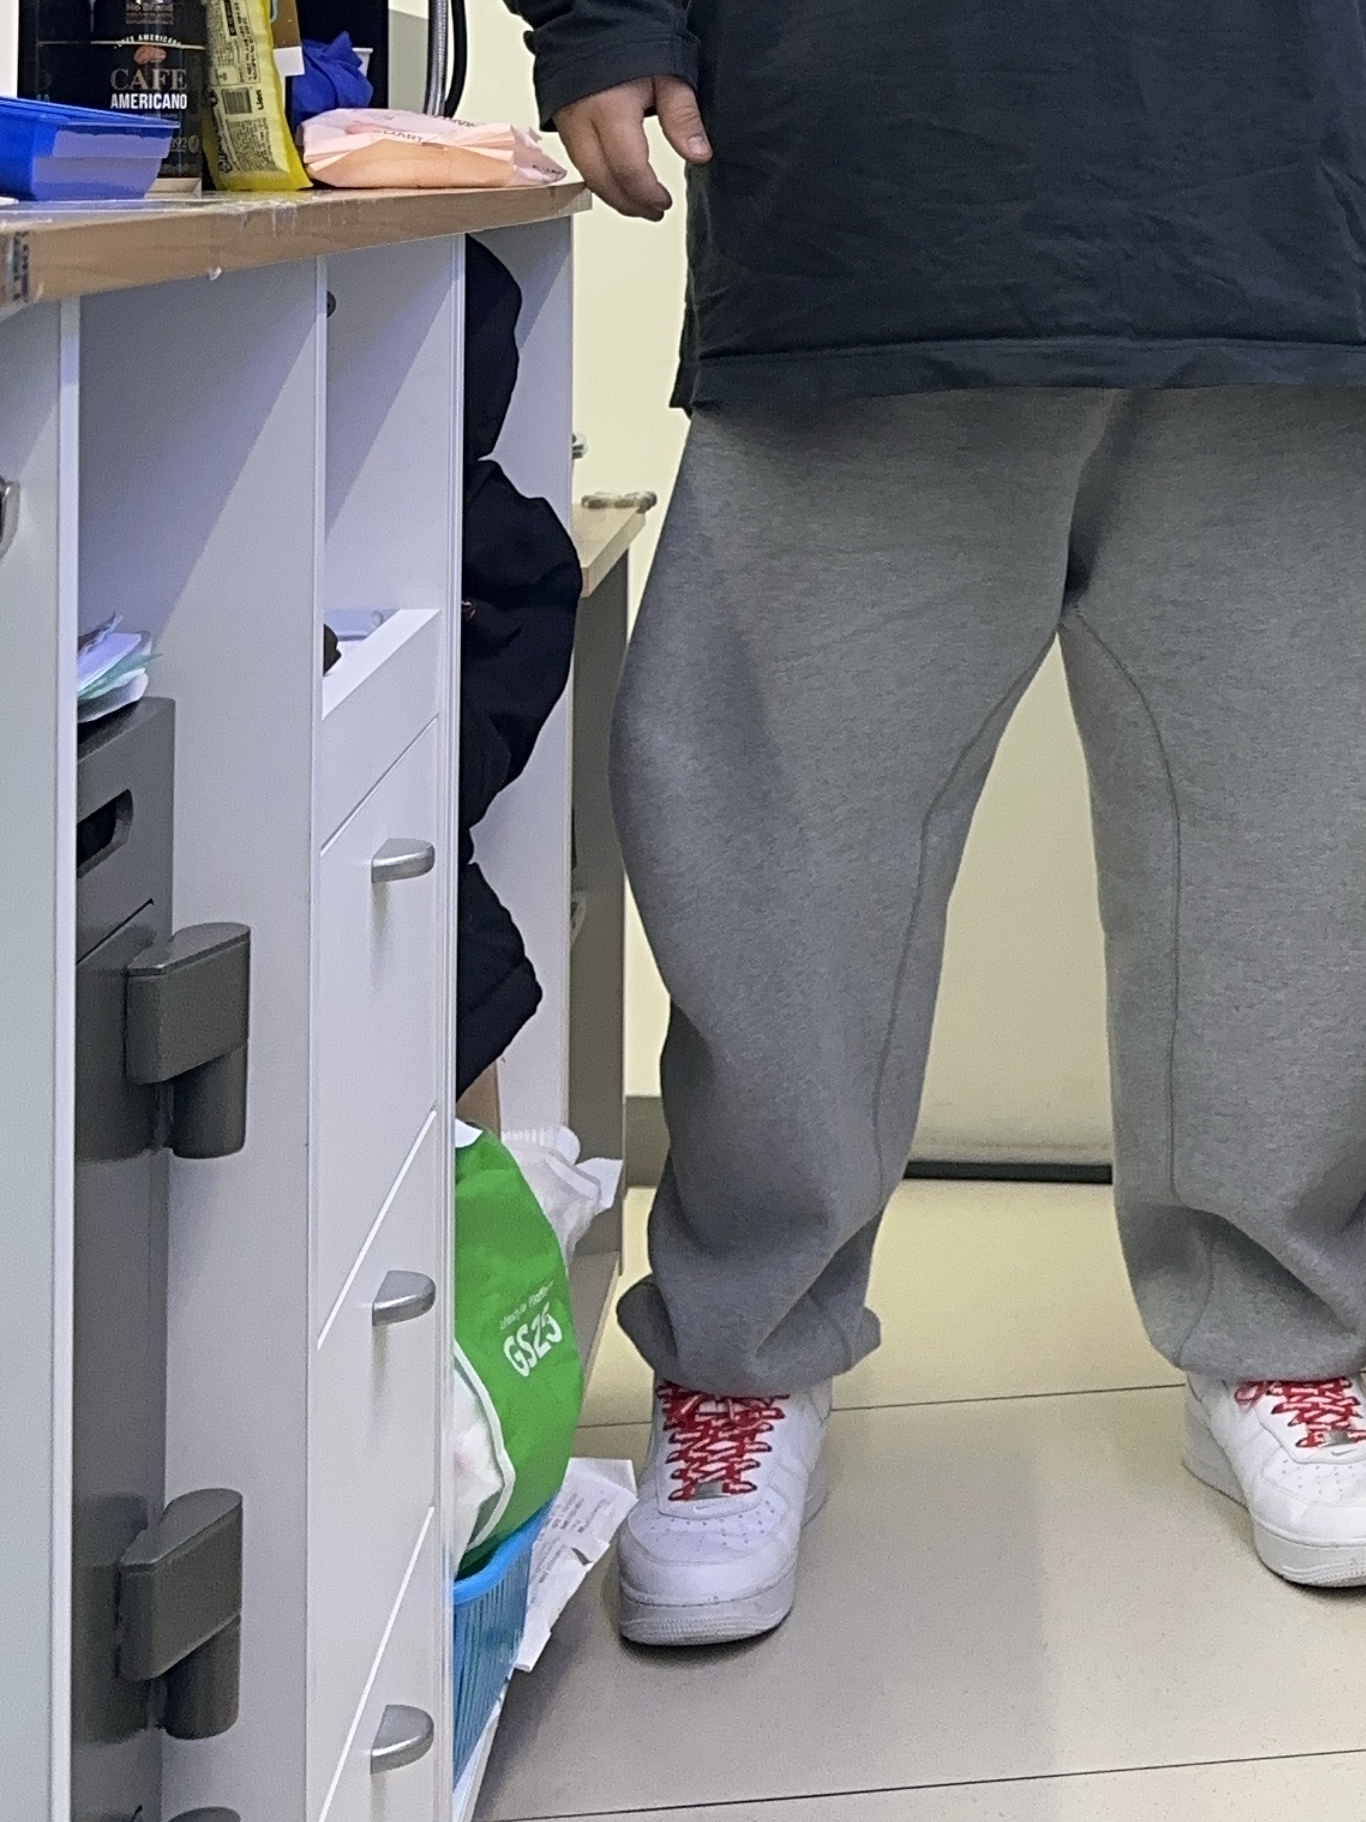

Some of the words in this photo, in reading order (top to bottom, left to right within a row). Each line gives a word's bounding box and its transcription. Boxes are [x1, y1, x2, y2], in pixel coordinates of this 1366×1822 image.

[109, 68, 188, 92] CAFE
[110, 93, 188, 110] AMERICANO
[502, 1300, 563, 1377] GS25
